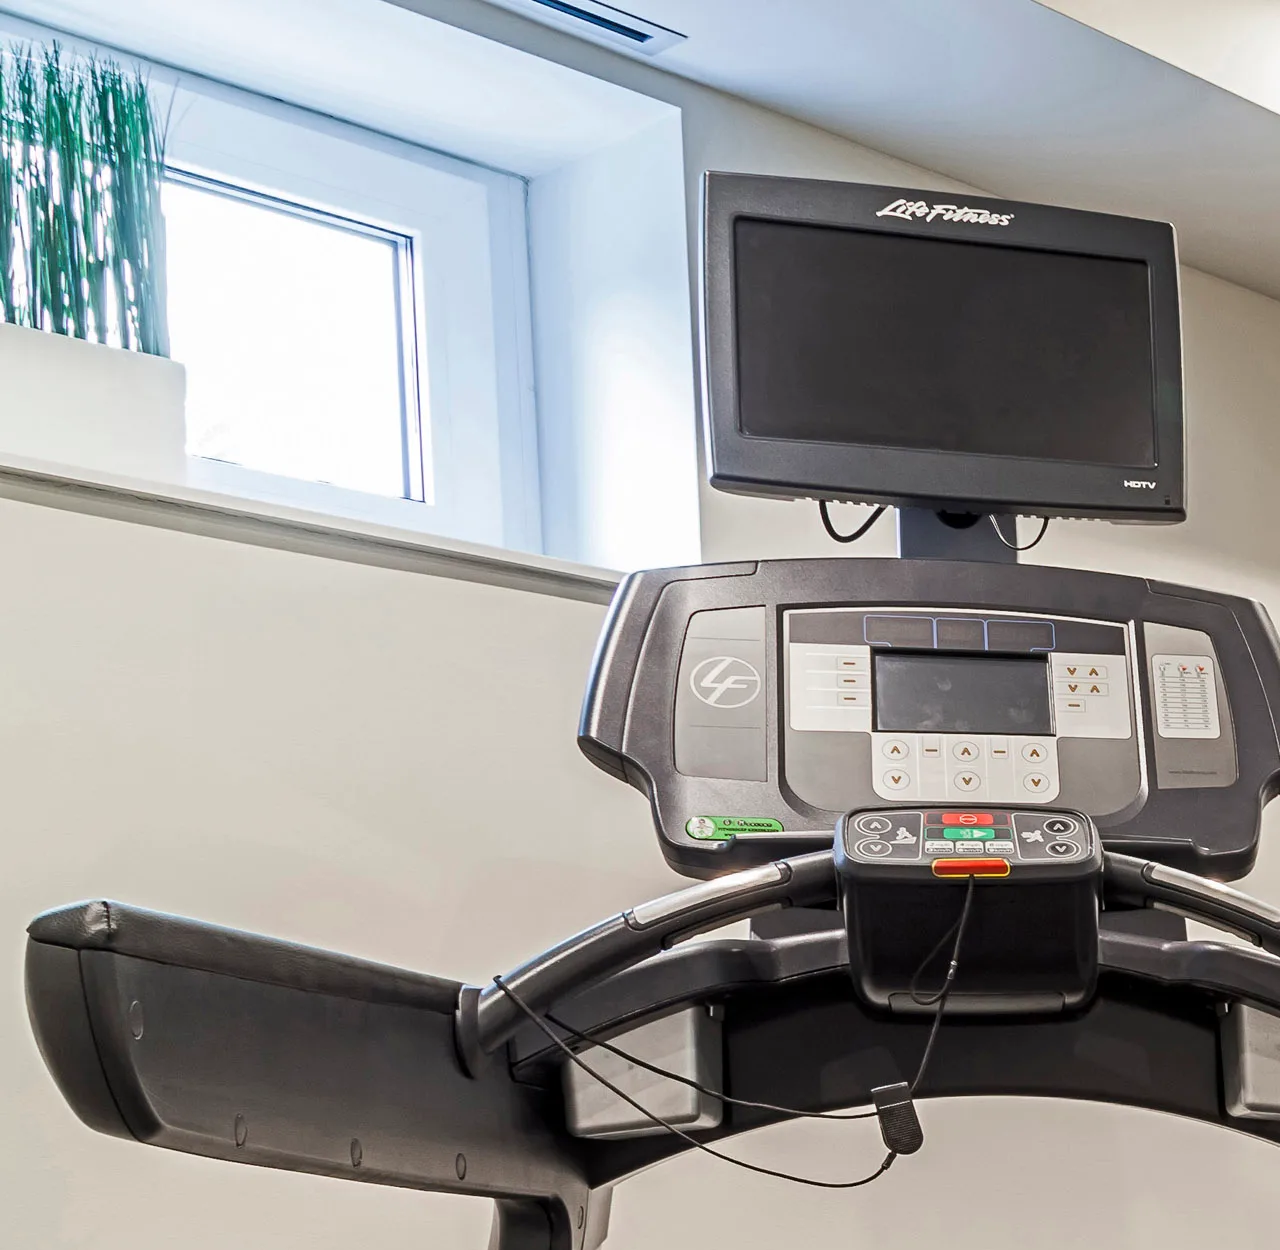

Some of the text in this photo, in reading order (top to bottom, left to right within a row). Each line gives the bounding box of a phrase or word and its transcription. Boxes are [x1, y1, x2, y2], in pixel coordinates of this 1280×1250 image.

[876, 199, 1013, 226] Life Fitness
[1124, 480, 1156, 489] HDTV
